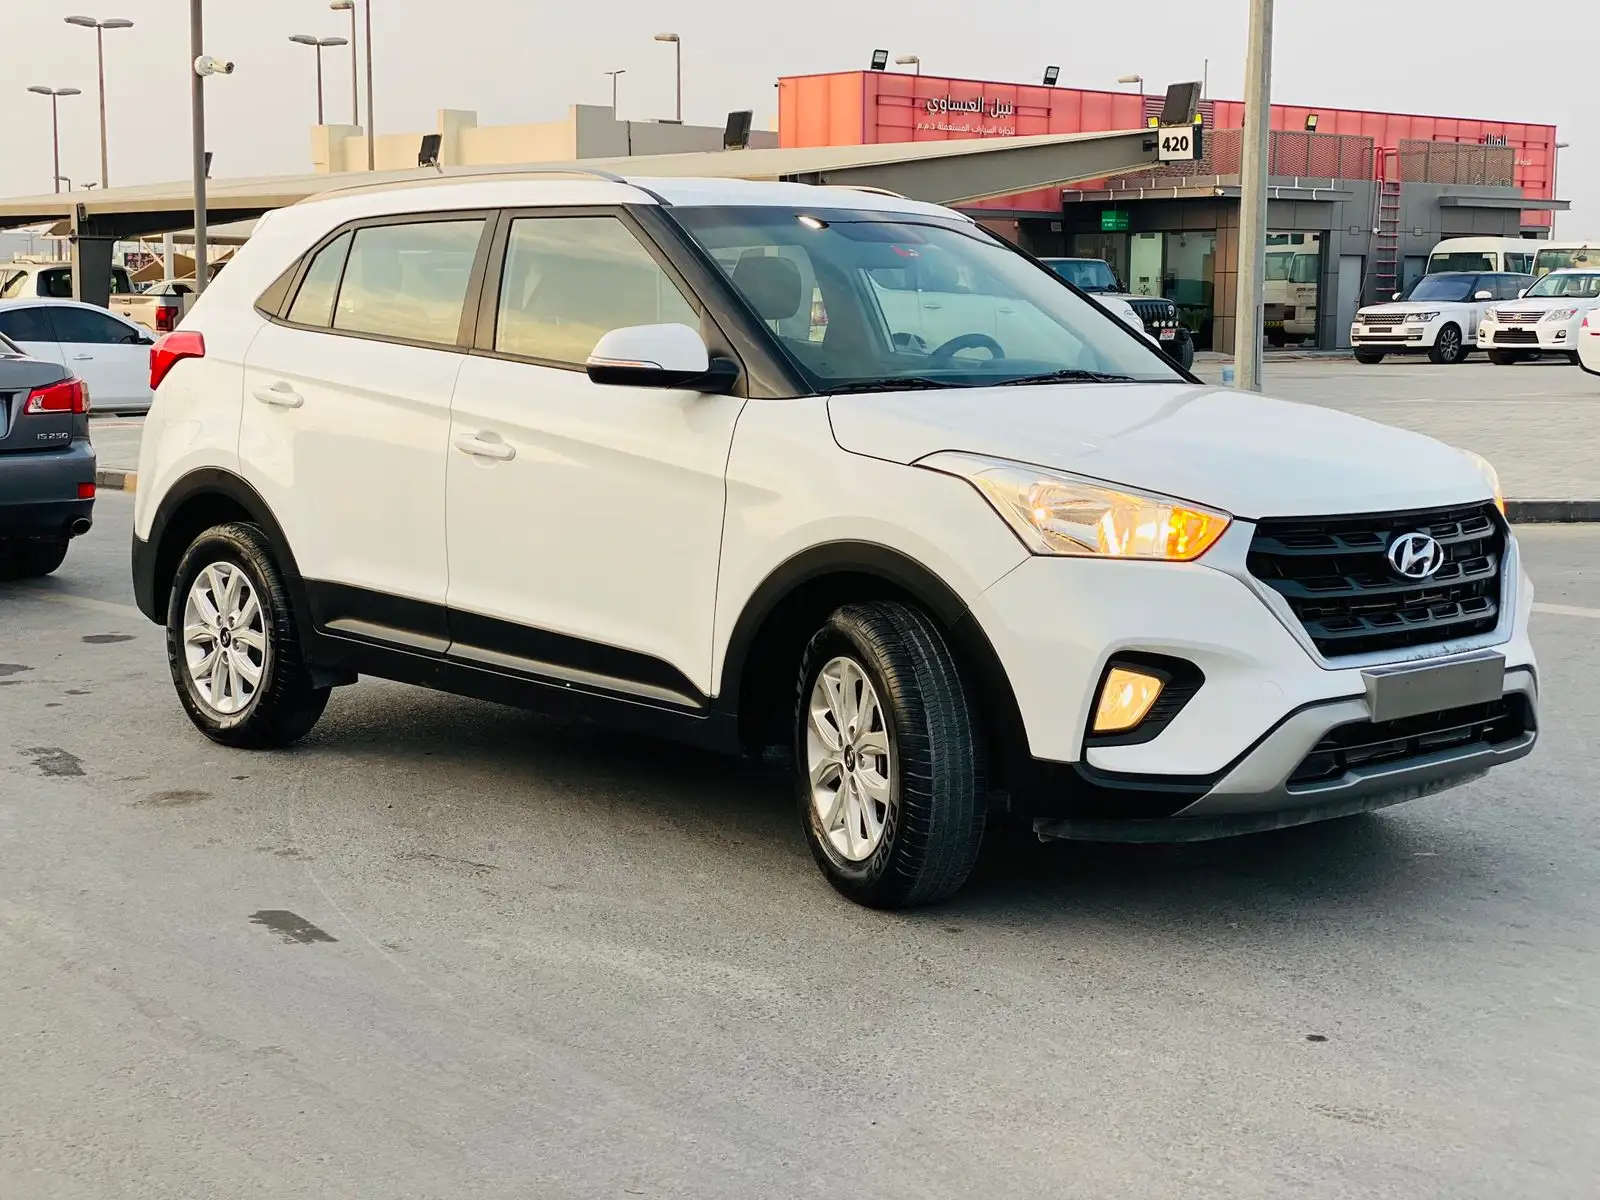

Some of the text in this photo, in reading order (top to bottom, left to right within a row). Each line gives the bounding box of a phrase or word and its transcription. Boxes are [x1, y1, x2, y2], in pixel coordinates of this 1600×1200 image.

[926, 94, 1013, 119] نبيل العيساوي
[1162, 135, 1189, 152] 420
